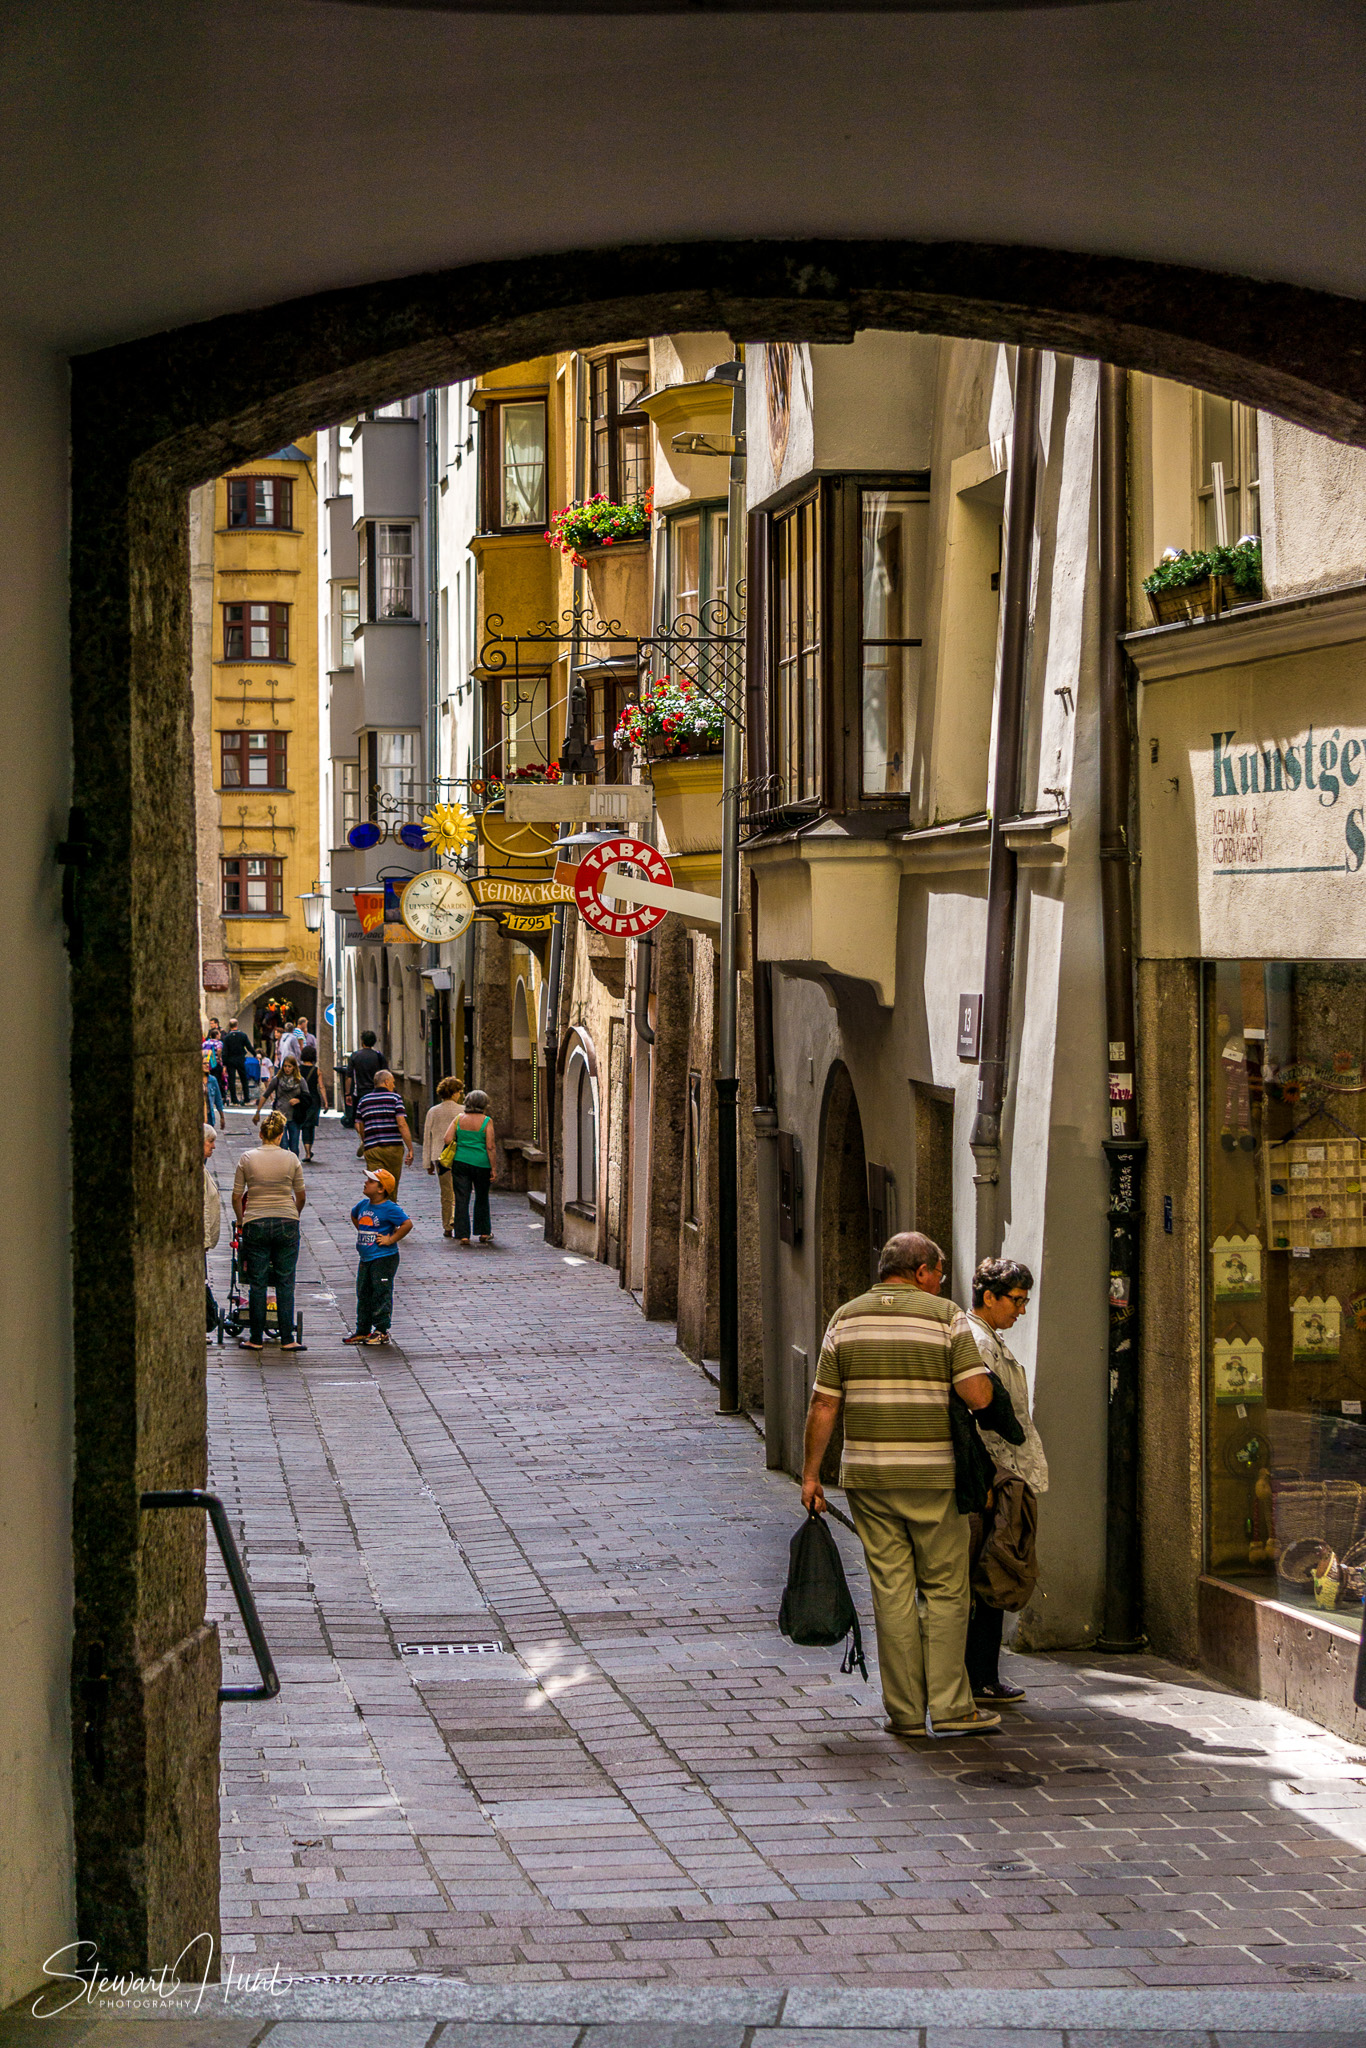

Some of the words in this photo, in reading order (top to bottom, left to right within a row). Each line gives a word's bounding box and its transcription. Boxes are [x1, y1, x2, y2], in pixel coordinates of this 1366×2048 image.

[1211, 724, 1366, 807] Kunstge
[1213, 808, 1247, 834] KERAMIK
[585, 843, 666, 879] TABAK
[513, 917, 545, 930] 1795
[579, 886, 658, 932] TRAFIK
[964, 1007, 972, 1032] 13
